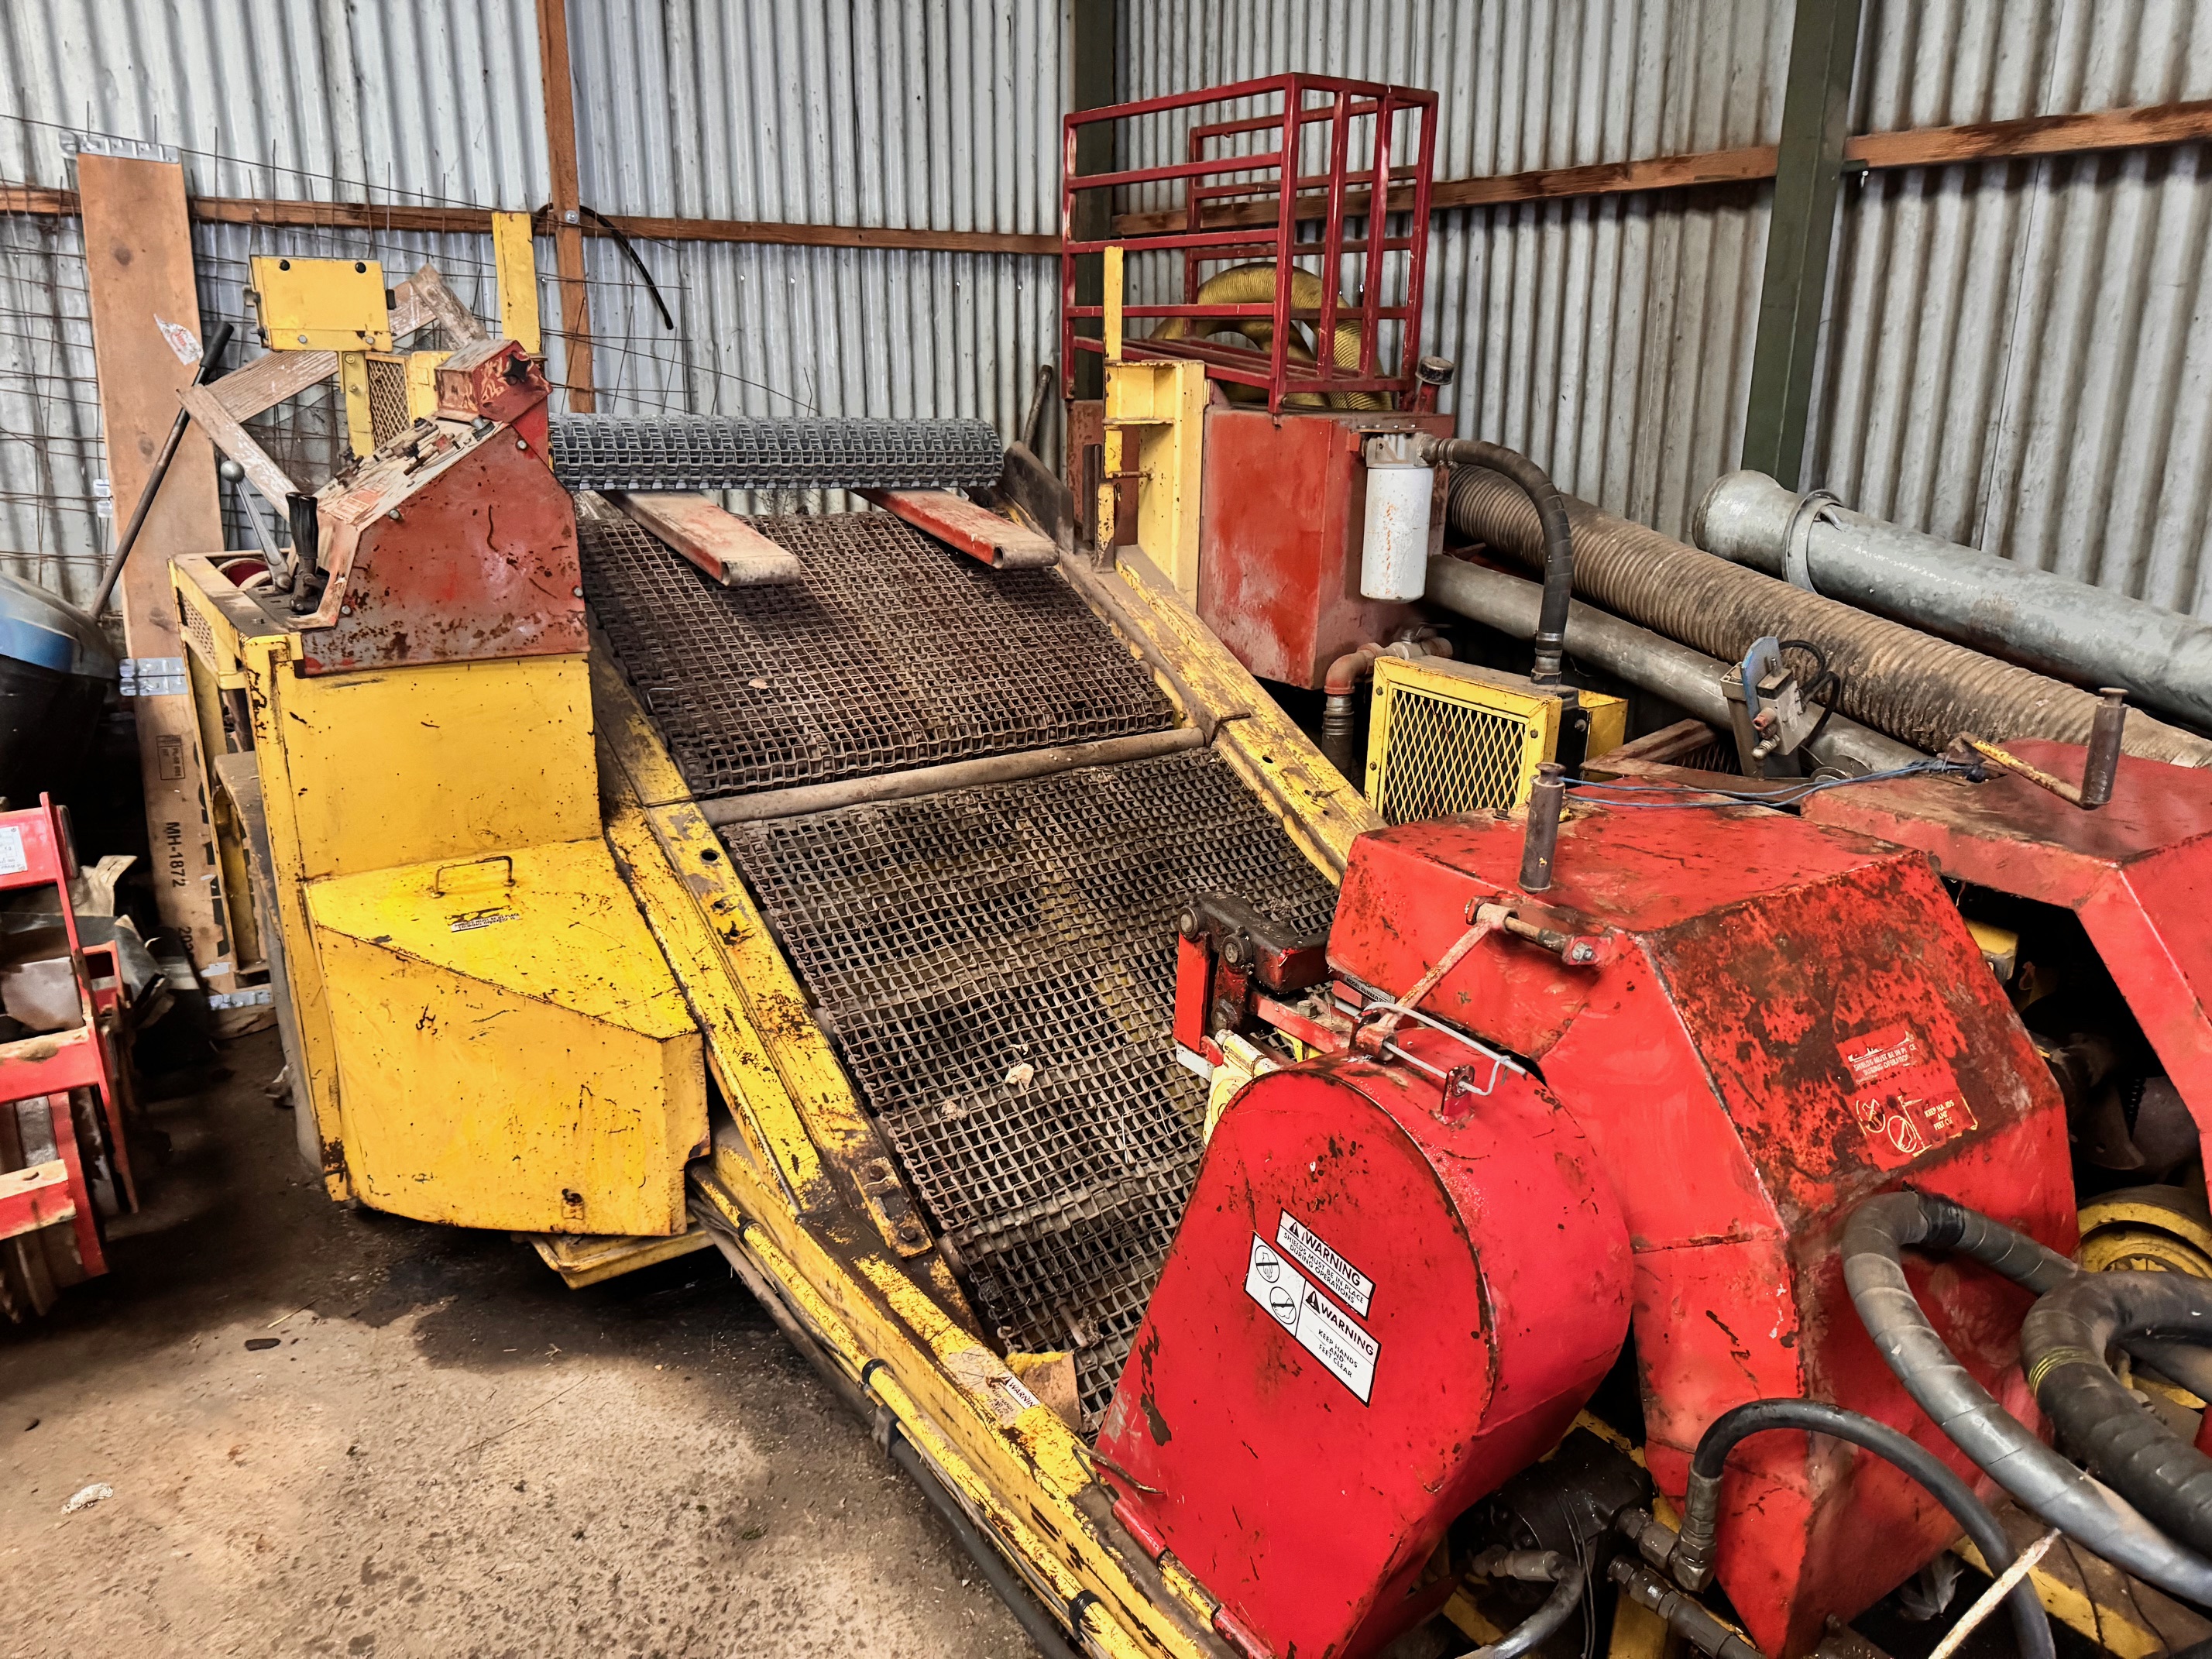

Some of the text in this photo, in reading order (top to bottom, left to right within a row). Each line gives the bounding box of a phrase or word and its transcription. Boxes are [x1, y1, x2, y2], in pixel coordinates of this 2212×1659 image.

[165, 822, 186, 888] MH-1872
[1346, 977, 1361, 990] MODEL
[1360, 987, 1379, 1001] NUMBER
[1874, 1053, 1888, 1064] MUST
[1887, 1051, 1895, 1060] BE
[1924, 1099, 1955, 1118] KEEP HADS
[1933, 1120, 1945, 1131] FEET
[1283, 1232, 1364, 1304] SHIELDS MUST BE IN PLACE
[1290, 1244, 1355, 1304] DURING OPERATIONS
[1304, 1231, 1361, 1286] WARNING
[1321, 1302, 1374, 1356] WARNING
[1318, 1328, 1358, 1368] KEEP HANDS
[1318, 1344, 1352, 1378] FEET CLEAR
[1329, 1347, 1345, 1362] AND
